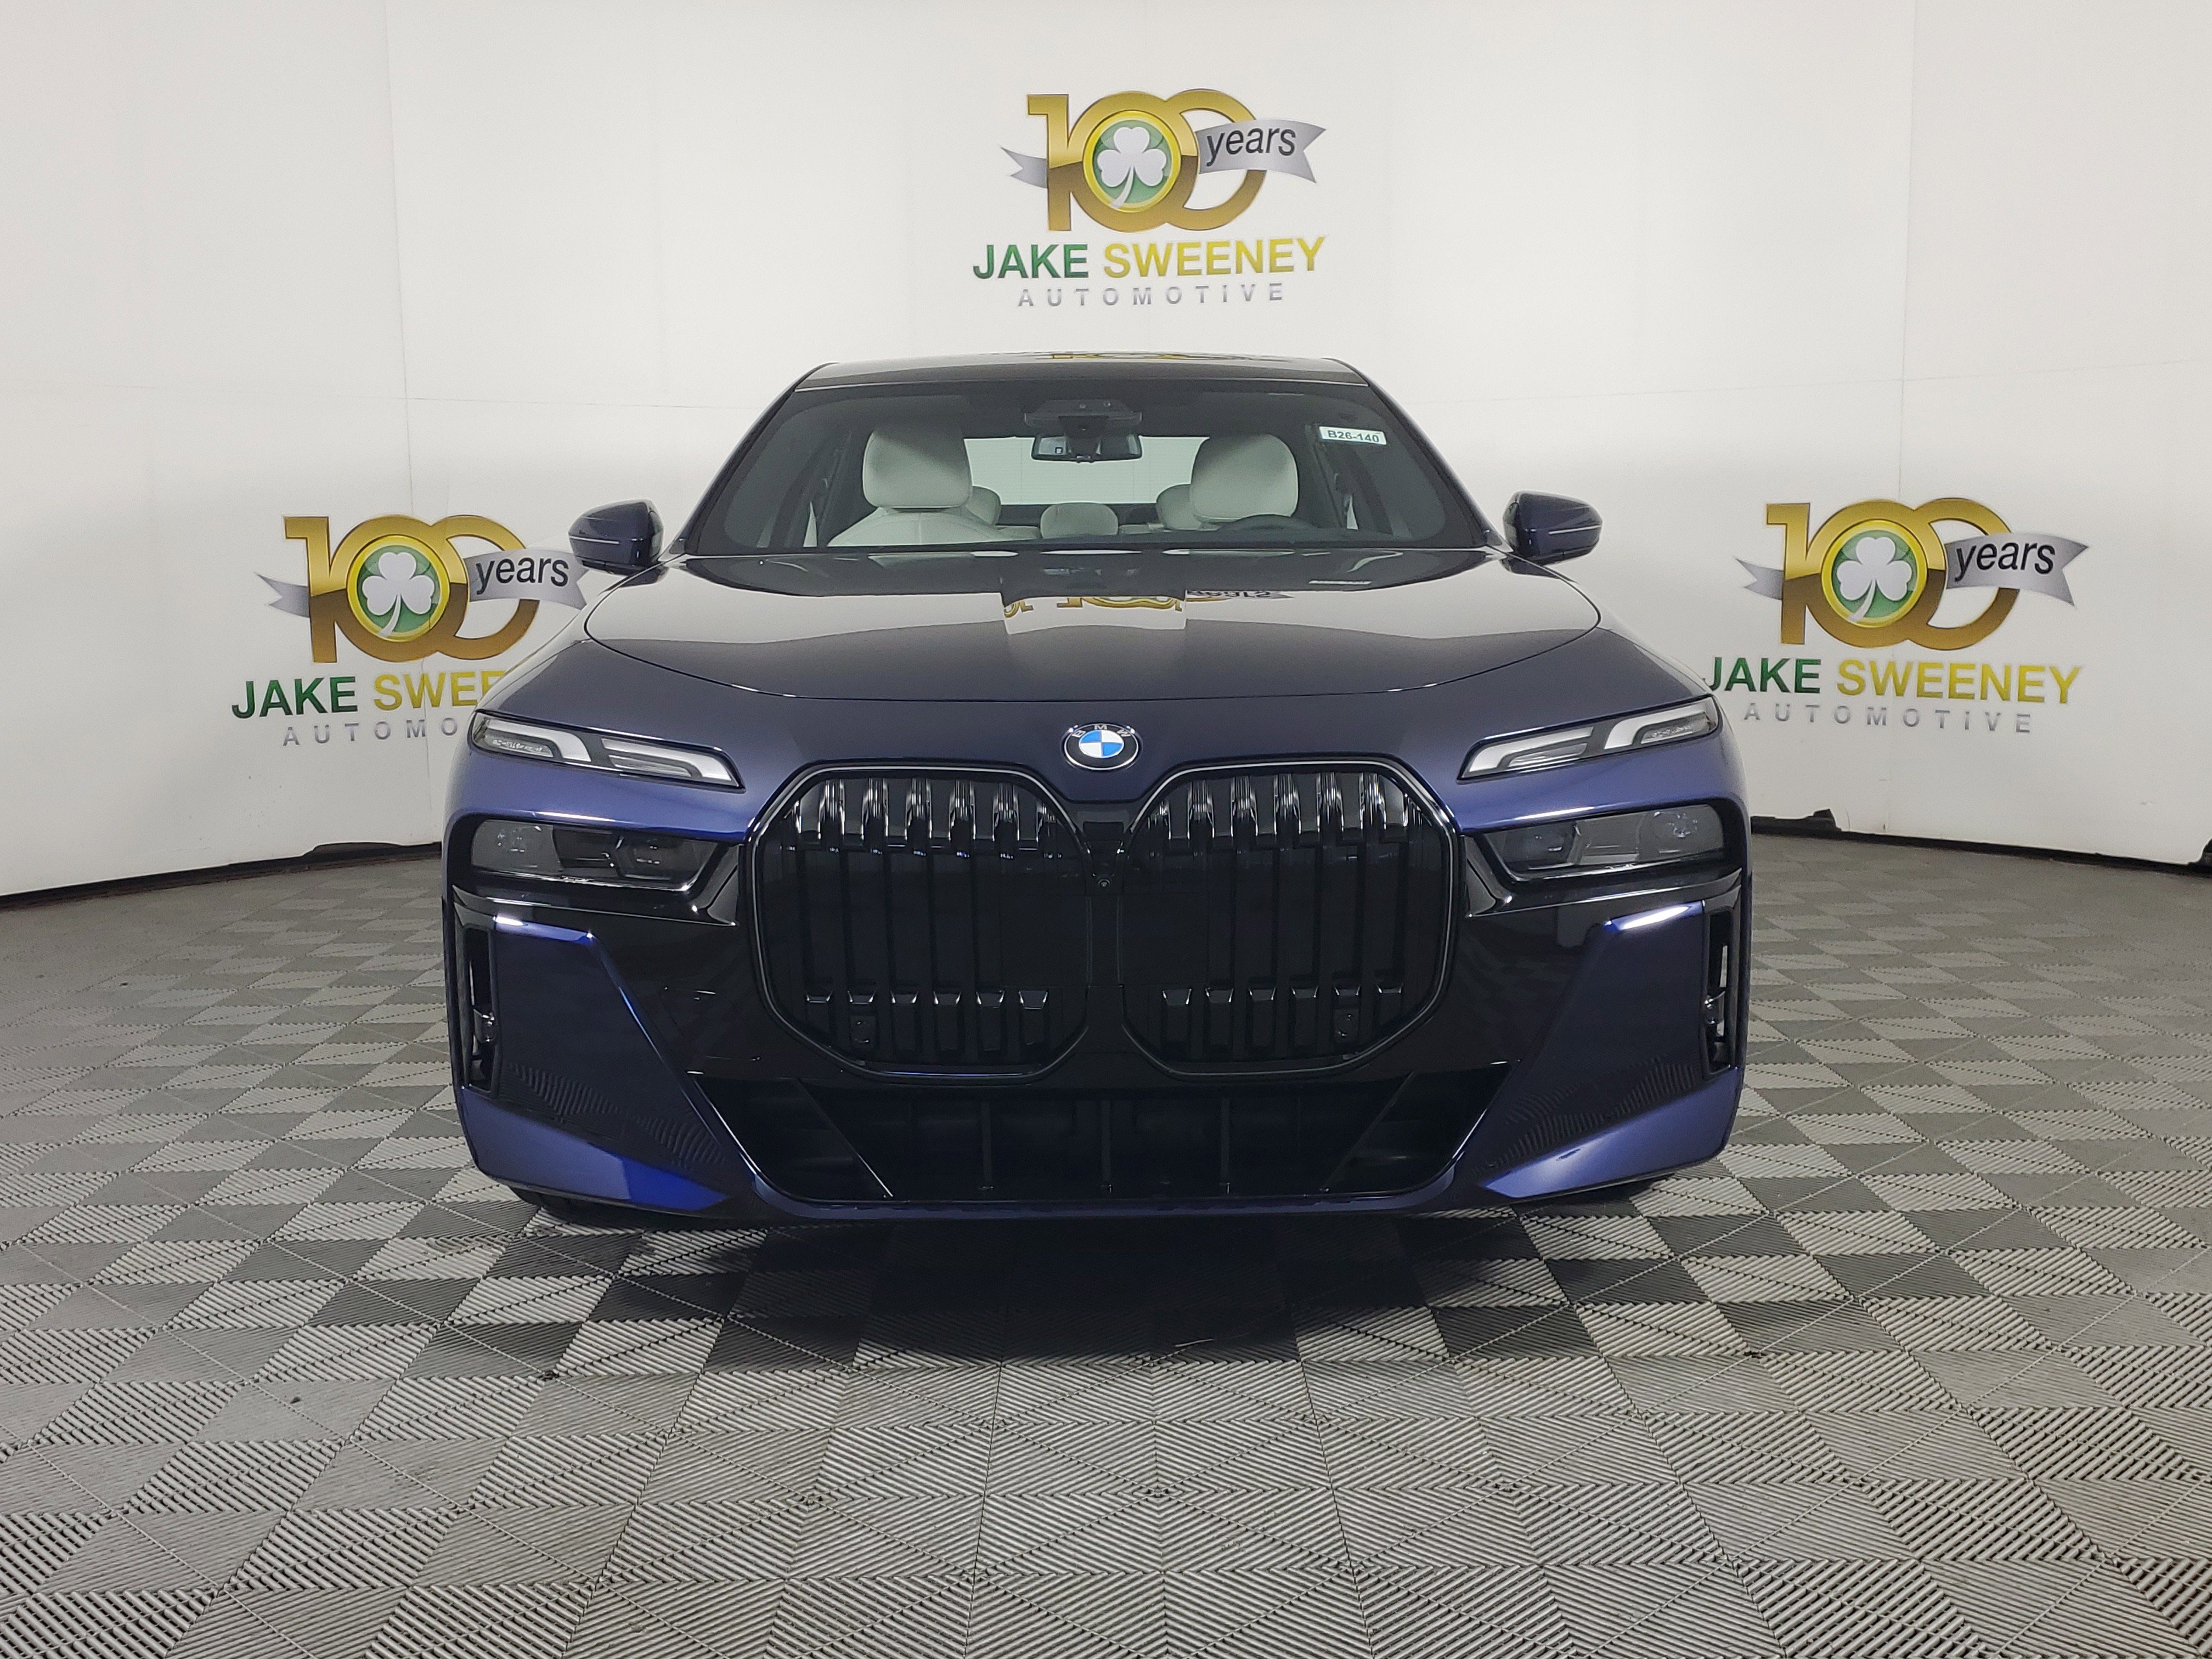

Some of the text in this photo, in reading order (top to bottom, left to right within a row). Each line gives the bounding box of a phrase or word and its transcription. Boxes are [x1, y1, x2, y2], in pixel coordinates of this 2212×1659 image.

[1026, 88, 1296, 233] 100 years
[973, 236, 1325, 279] JAKE SWEENEY
[1017, 282, 1284, 307] AUTOMOTIVE
[1327, 430, 1380, 443] B26-140
[283, 514, 569, 664] 100 years
[1765, 497, 2056, 651] 100 years
[231, 675, 358, 719] JAKE
[1702, 656, 2082, 705] JAKE SWEENEY
[283, 717, 458, 747] AUTOMO
[1071, 725, 1131, 738] BMW
[1743, 702, 2031, 733] AUTOMOTIVE
